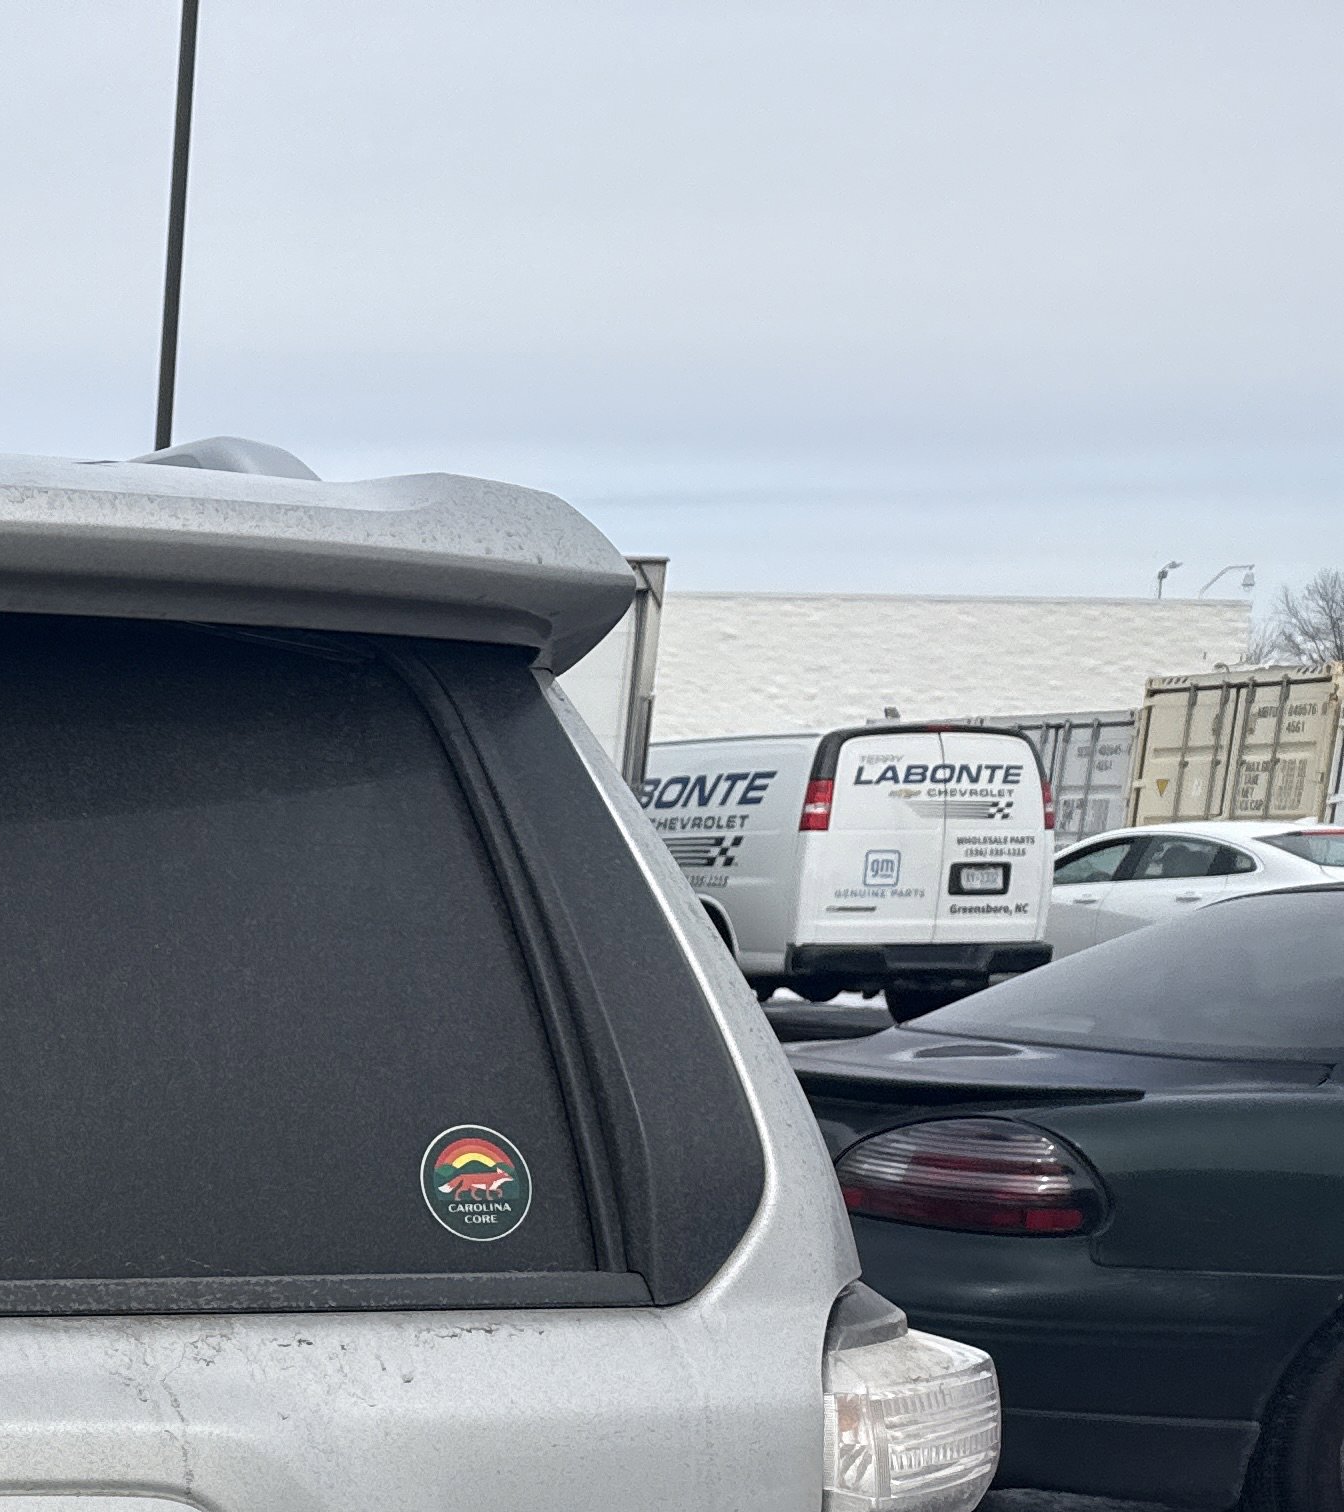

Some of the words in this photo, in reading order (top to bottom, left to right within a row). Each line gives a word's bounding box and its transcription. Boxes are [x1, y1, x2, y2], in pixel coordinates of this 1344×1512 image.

[853, 763, 1024, 785] LABONTE
[926, 787, 1015, 798] CHEVROLET
[957, 835, 1008, 845] WHOLESALE
[1010, 835, 1035, 845] PARTS
[891, 888, 926, 898] PARTS
[949, 903, 1012, 916] Greensboro,
[1015, 903, 1029, 914] NC
[448, 1202, 512, 1213] CAROLINA
[464, 1214, 499, 1224] CORE
